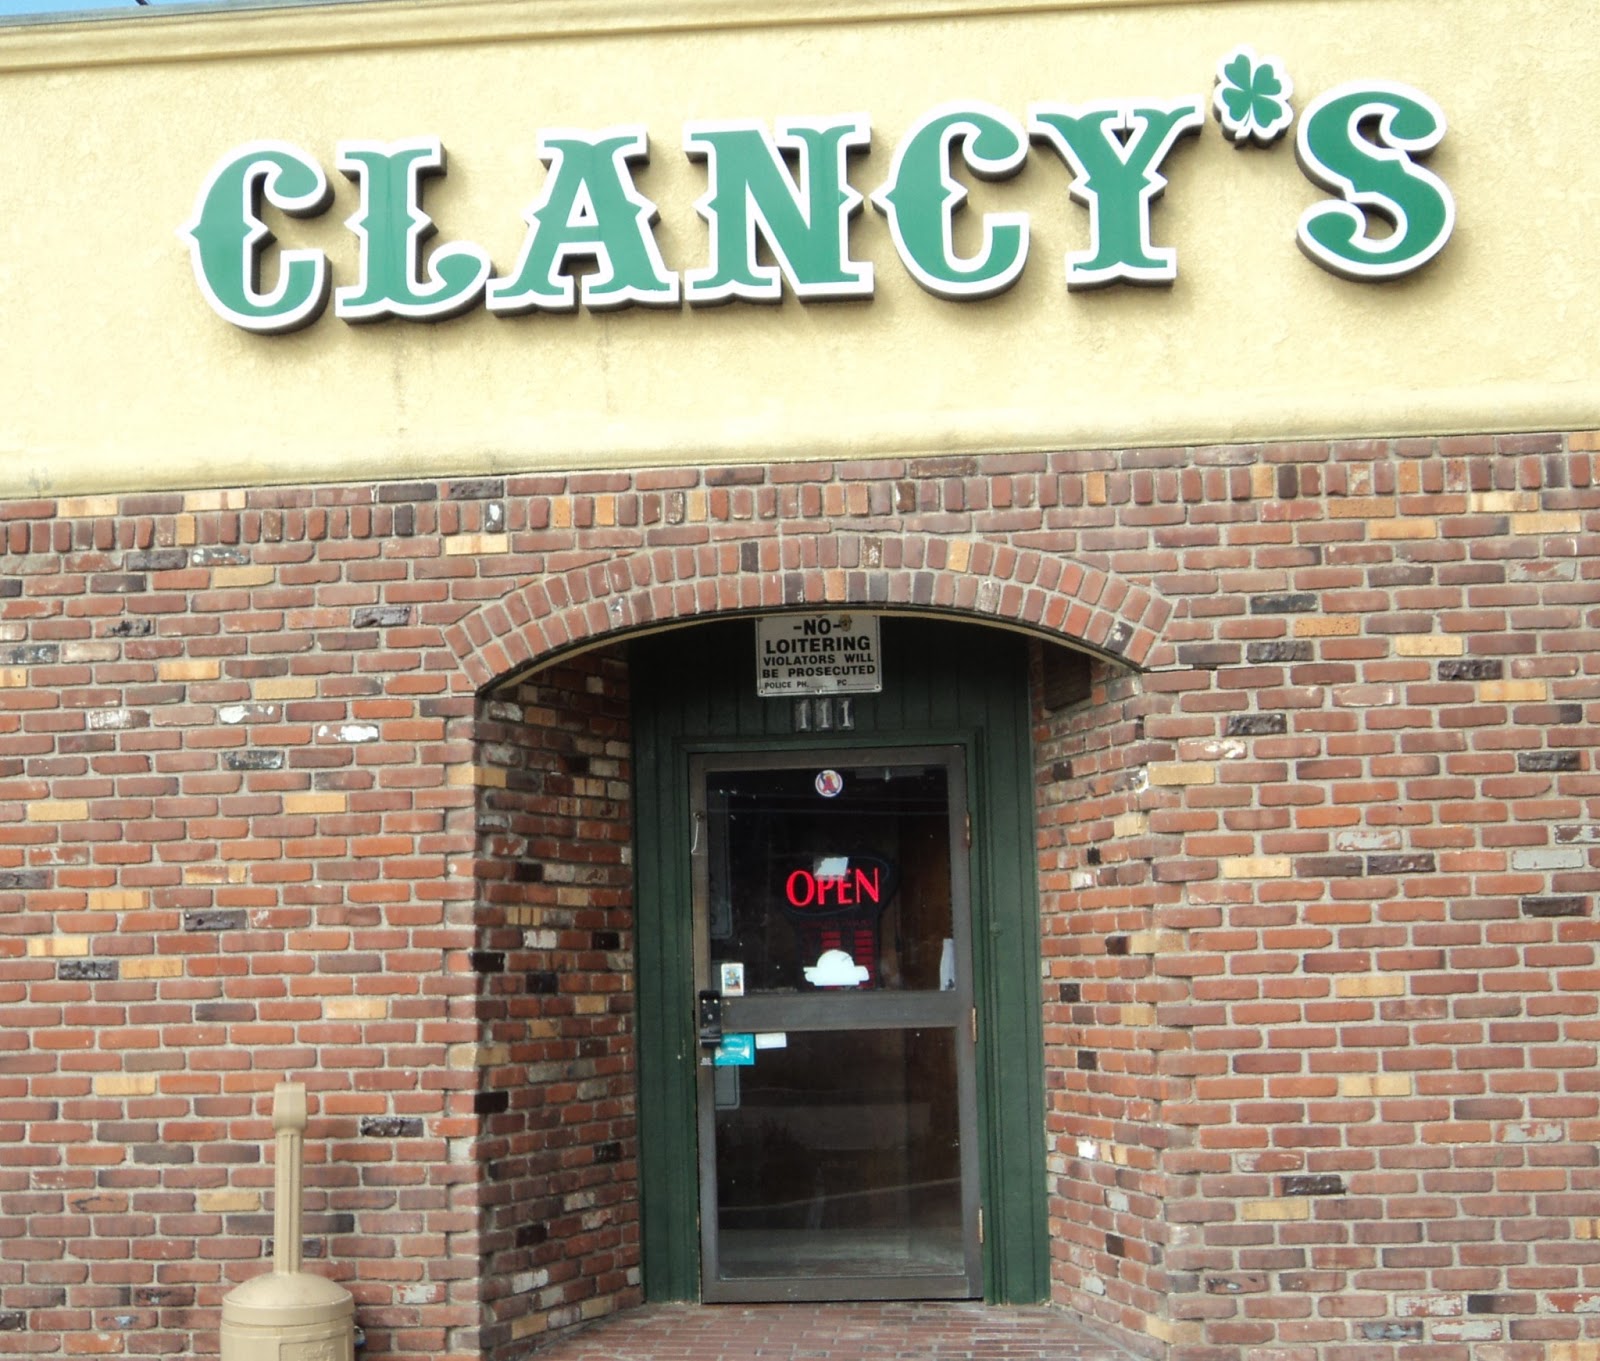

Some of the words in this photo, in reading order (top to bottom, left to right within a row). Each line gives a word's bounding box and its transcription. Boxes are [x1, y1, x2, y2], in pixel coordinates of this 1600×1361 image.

[178, 46, 1456, 332] CLANCY'S
[765, 636, 871, 654] LOITERING
[763, 654, 836, 666] VIOLATORS
[844, 653, 874, 664] WILL
[762, 669, 779, 679] BE
[788, 665, 876, 678] PROSECUTED
[764, 681, 792, 689] POLICE
[800, 700, 851, 729] 111
[786, 867, 880, 907] OPEN
